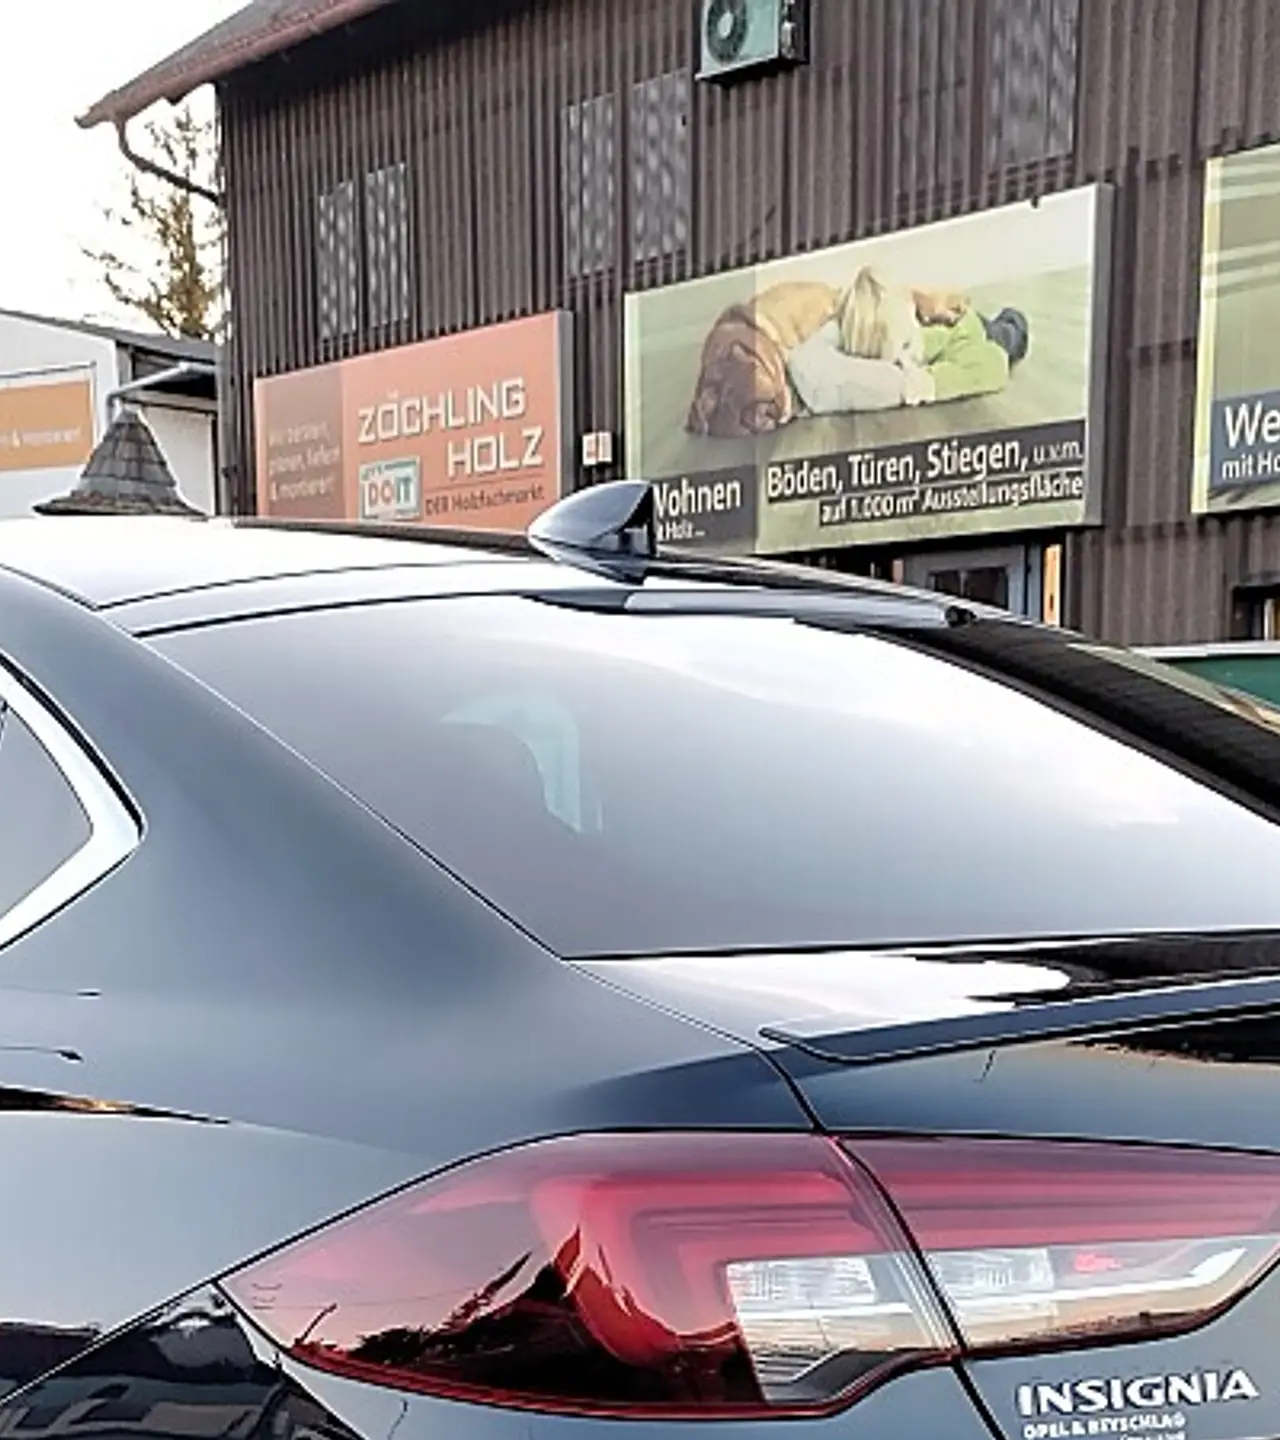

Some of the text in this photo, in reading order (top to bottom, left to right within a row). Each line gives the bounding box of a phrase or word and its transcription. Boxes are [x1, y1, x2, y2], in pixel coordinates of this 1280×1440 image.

[358, 377, 526, 444] ZÖCHLING
[448, 426, 543, 478] HOLZ
[768, 460, 844, 498] Böden,
[848, 453, 921, 486] Türen,
[927, 439, 1029, 481] Stiegen,
[1222, 453, 1253, 479] mit
[822, 495, 846, 523] auf
[922, 471, 1084, 512] Ausstellungsfläche
[1018, 1369, 1260, 1416] INSIGNIA
[1024, 1422, 1070, 1440] OPEL
